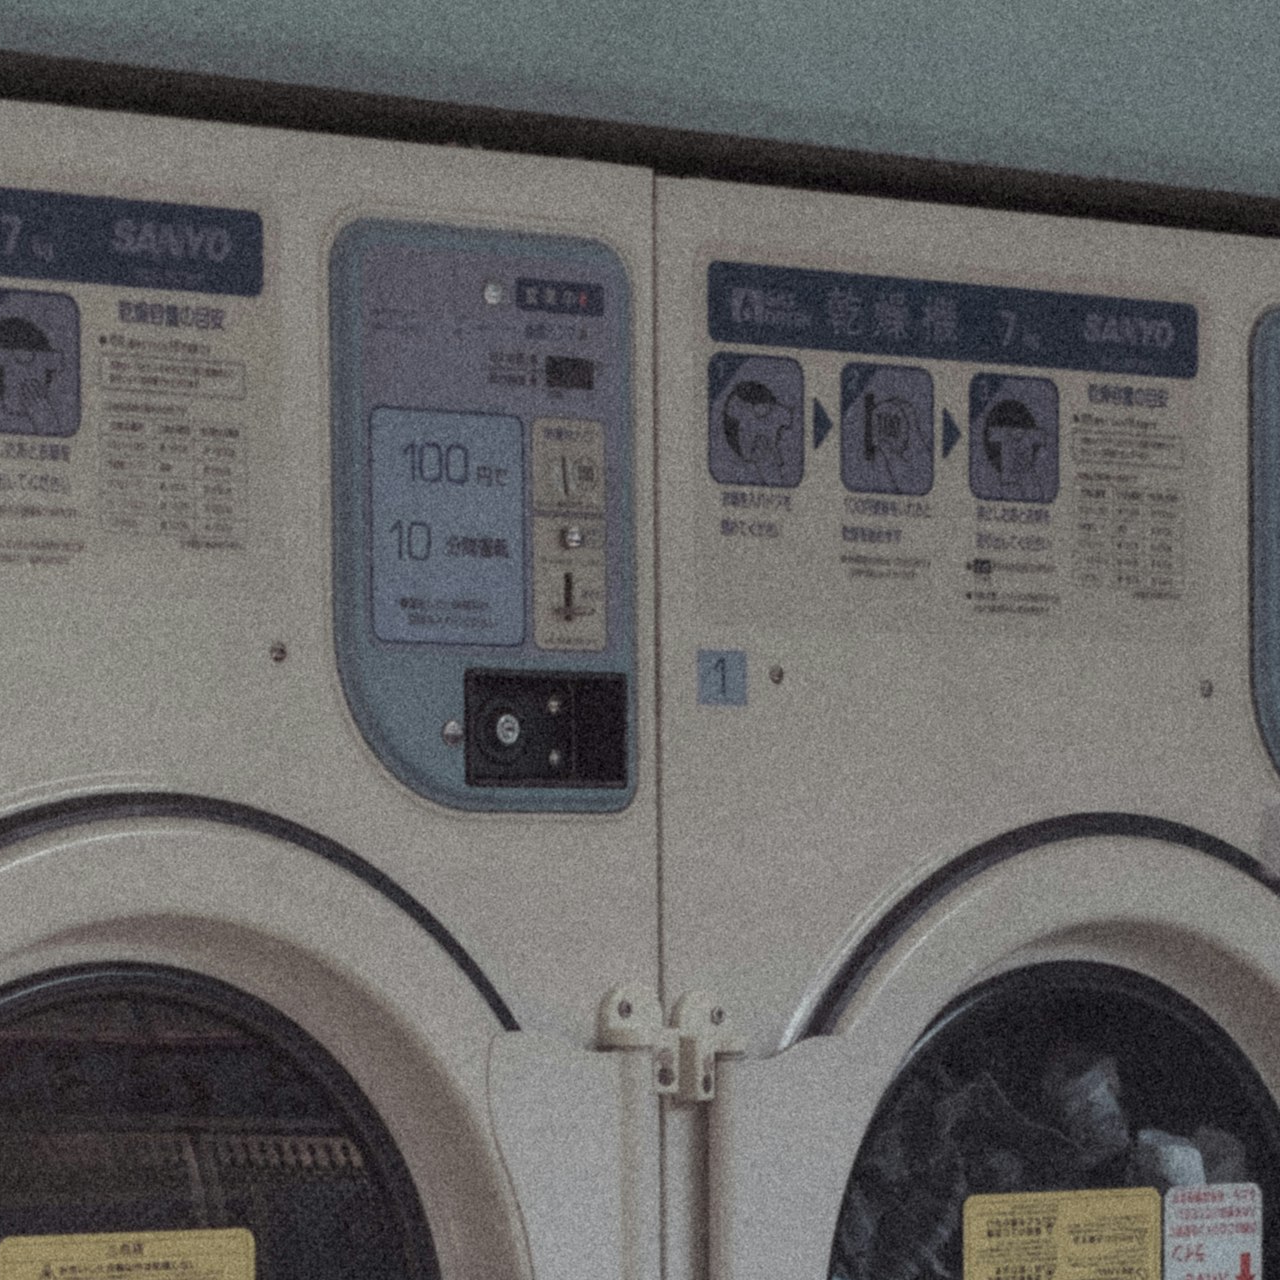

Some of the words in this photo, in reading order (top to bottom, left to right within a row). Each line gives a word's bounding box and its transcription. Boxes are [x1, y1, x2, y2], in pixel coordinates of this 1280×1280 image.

[110, 219, 234, 264] SANYO
[827, 286, 959, 343] 乾燥機
[1083, 313, 1176, 350] SANYO
[402, 441, 470, 484] 100
[389, 520, 433, 562] 10
